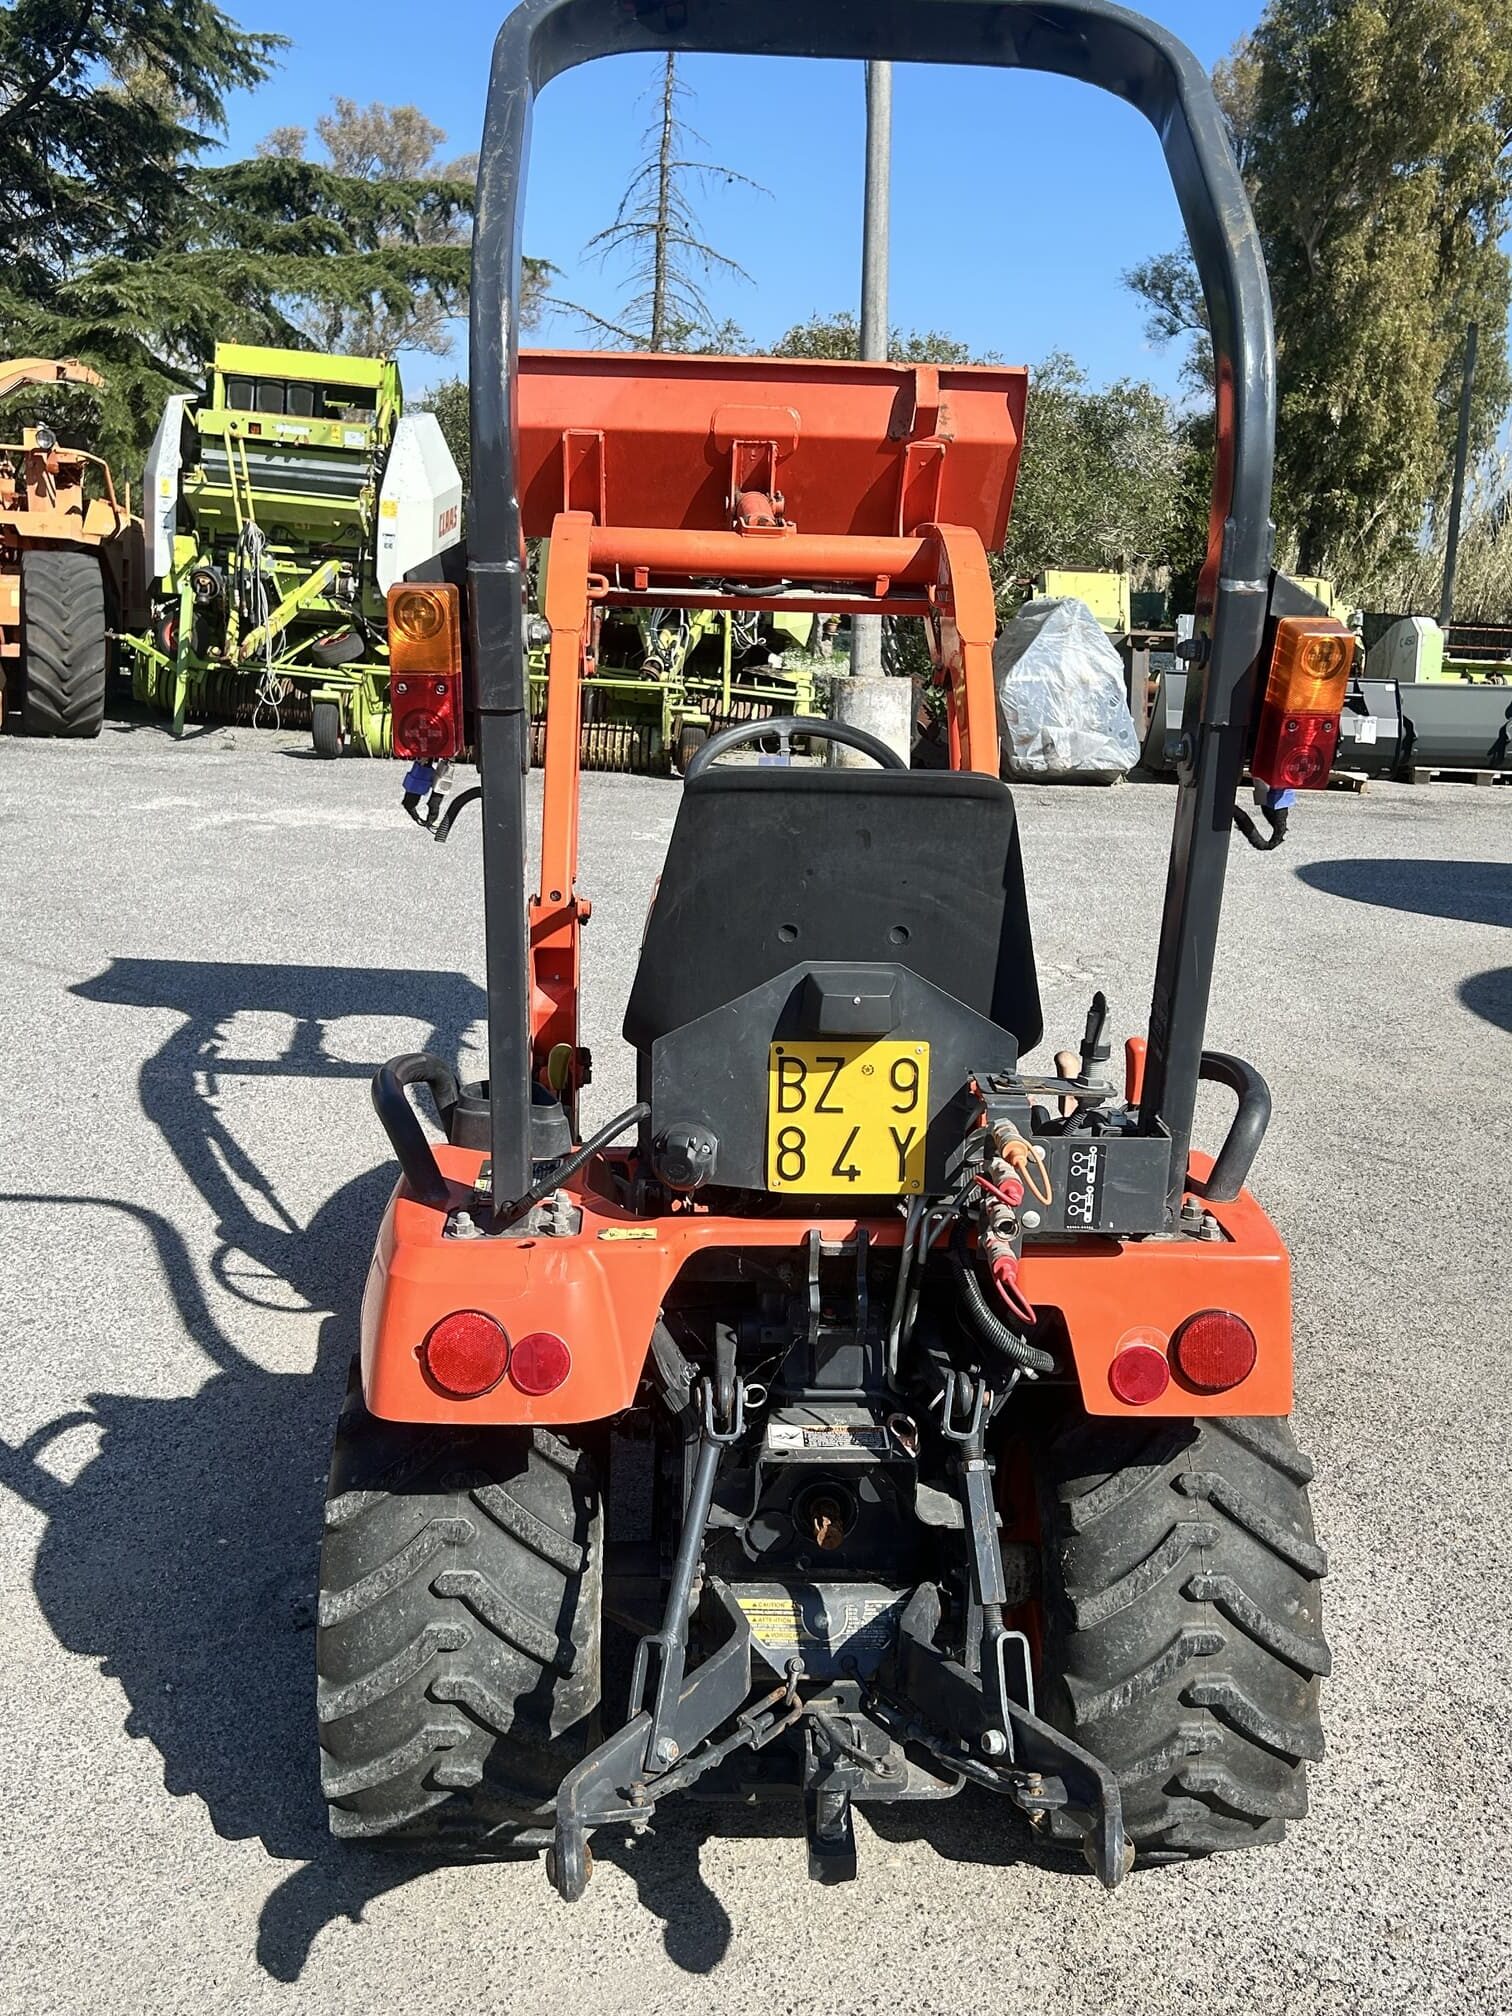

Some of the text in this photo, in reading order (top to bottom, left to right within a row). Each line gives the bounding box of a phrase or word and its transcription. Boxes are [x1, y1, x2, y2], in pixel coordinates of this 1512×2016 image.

[439, 504, 457, 538] CLAAS
[777, 1056, 920, 1114] BZ 9
